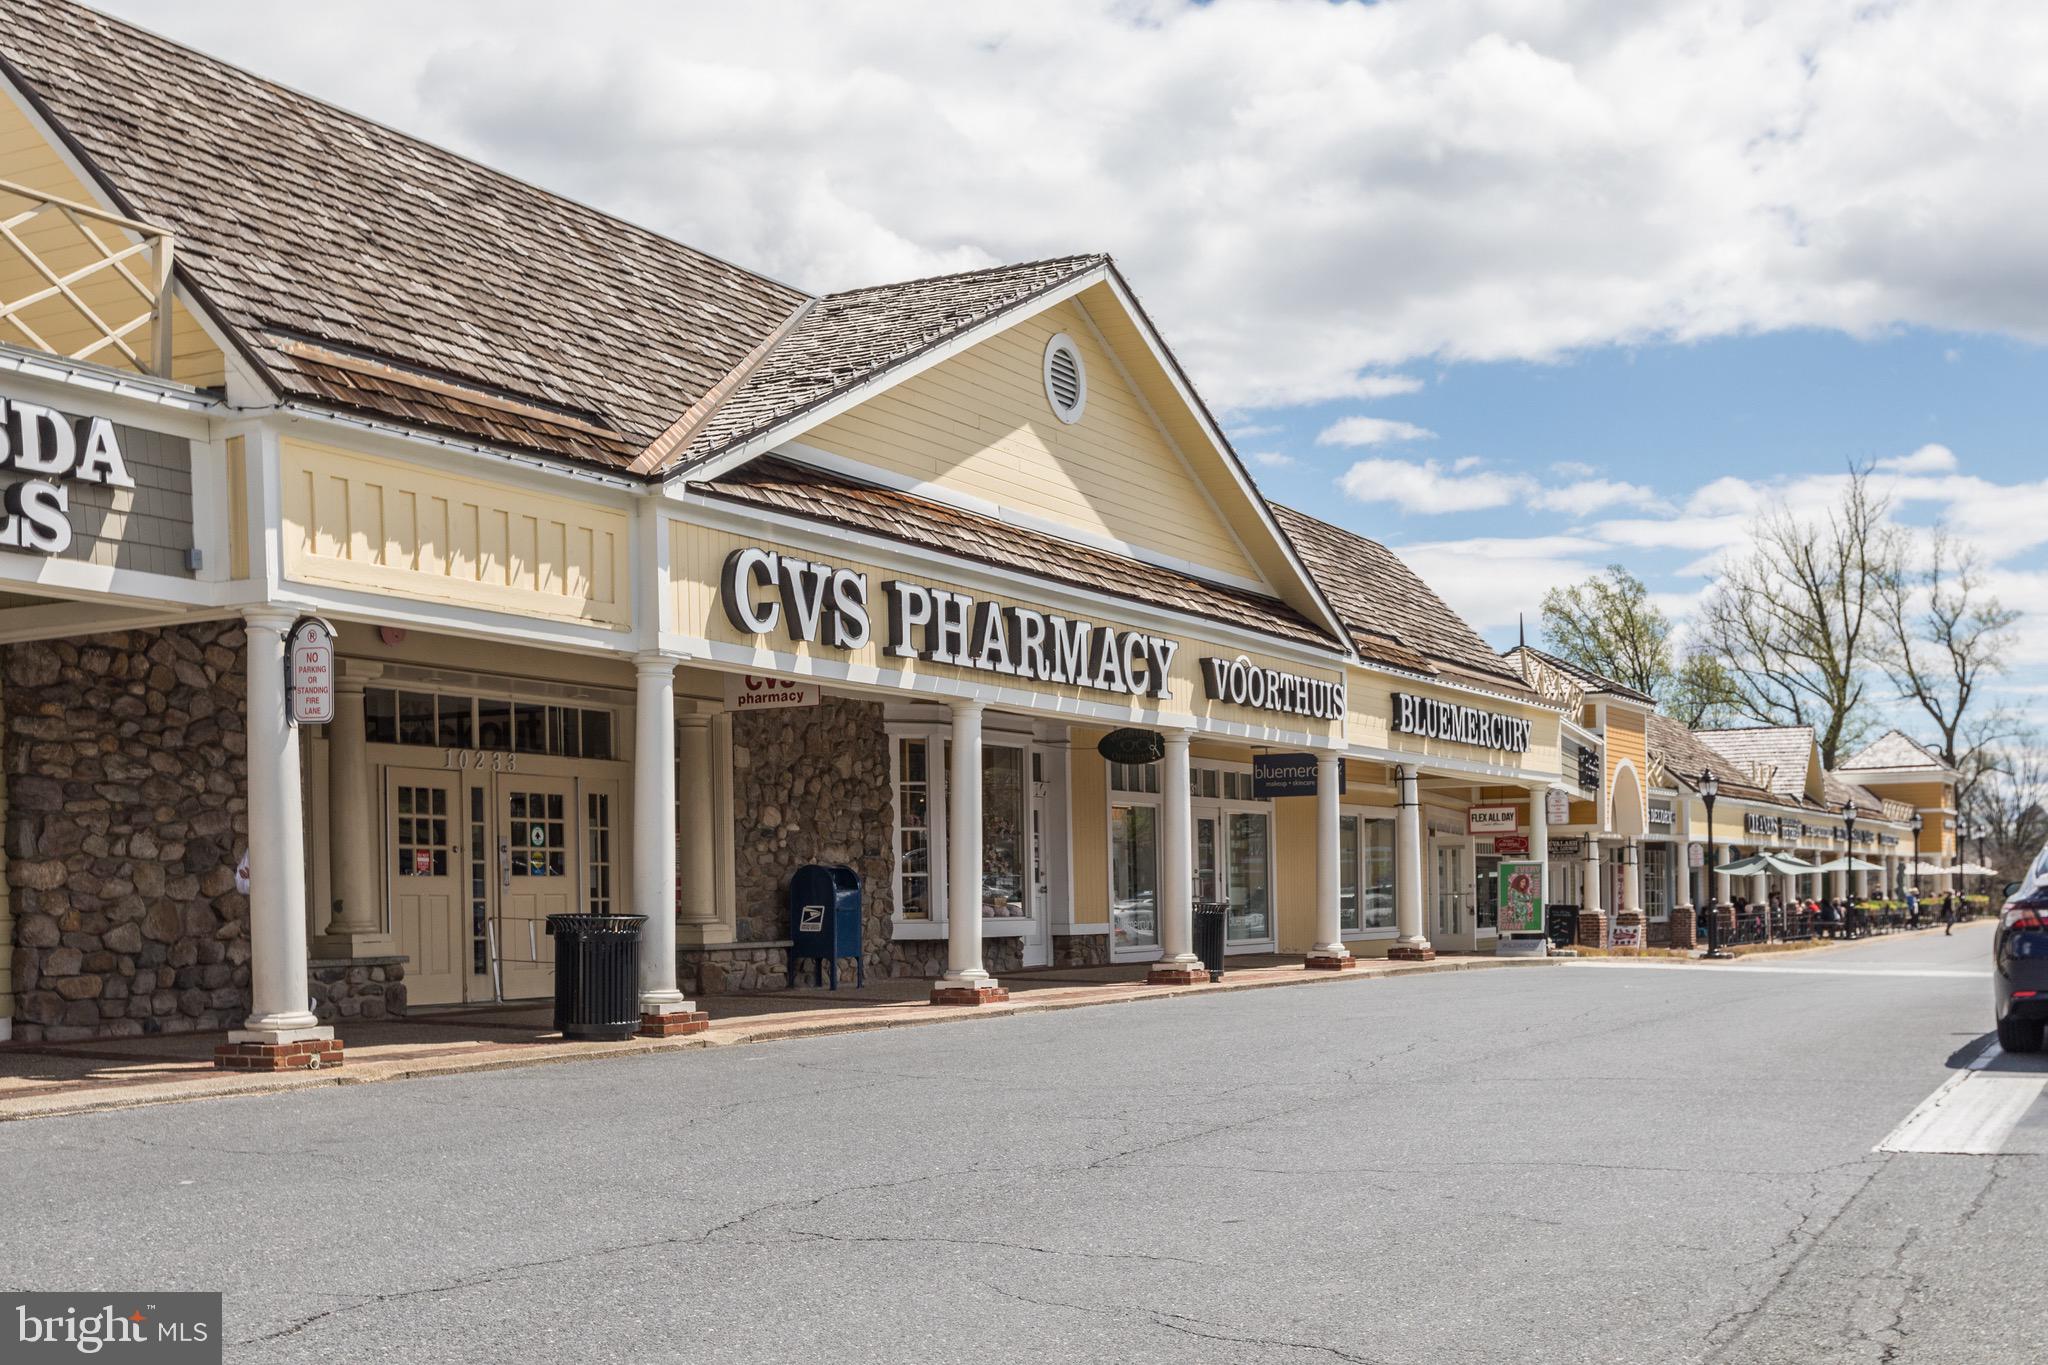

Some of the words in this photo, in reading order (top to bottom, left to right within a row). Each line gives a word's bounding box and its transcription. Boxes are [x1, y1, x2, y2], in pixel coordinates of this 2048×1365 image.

[0, 397, 136, 488] DA
[721, 547, 871, 650] CVS
[882, 580, 1179, 700] PHARMACY
[306, 652, 319, 663] NO
[298, 665, 327, 674] PARKING
[307, 676, 318, 684] OR
[296, 686, 329, 694] STANDING
[1200, 655, 1345, 721] VOORTHUIS
[305, 697, 320, 705] FIRE
[738, 690, 804, 707] pharmacy
[304, 706, 321, 715] LANE
[1392, 693, 1532, 753] BLUEMERCURY
[445, 750, 518, 772] 10233
[1471, 813, 1487, 823] FLEX
[1488, 812, 1500, 822] ALL
[1501, 811, 1514, 821] DAY
